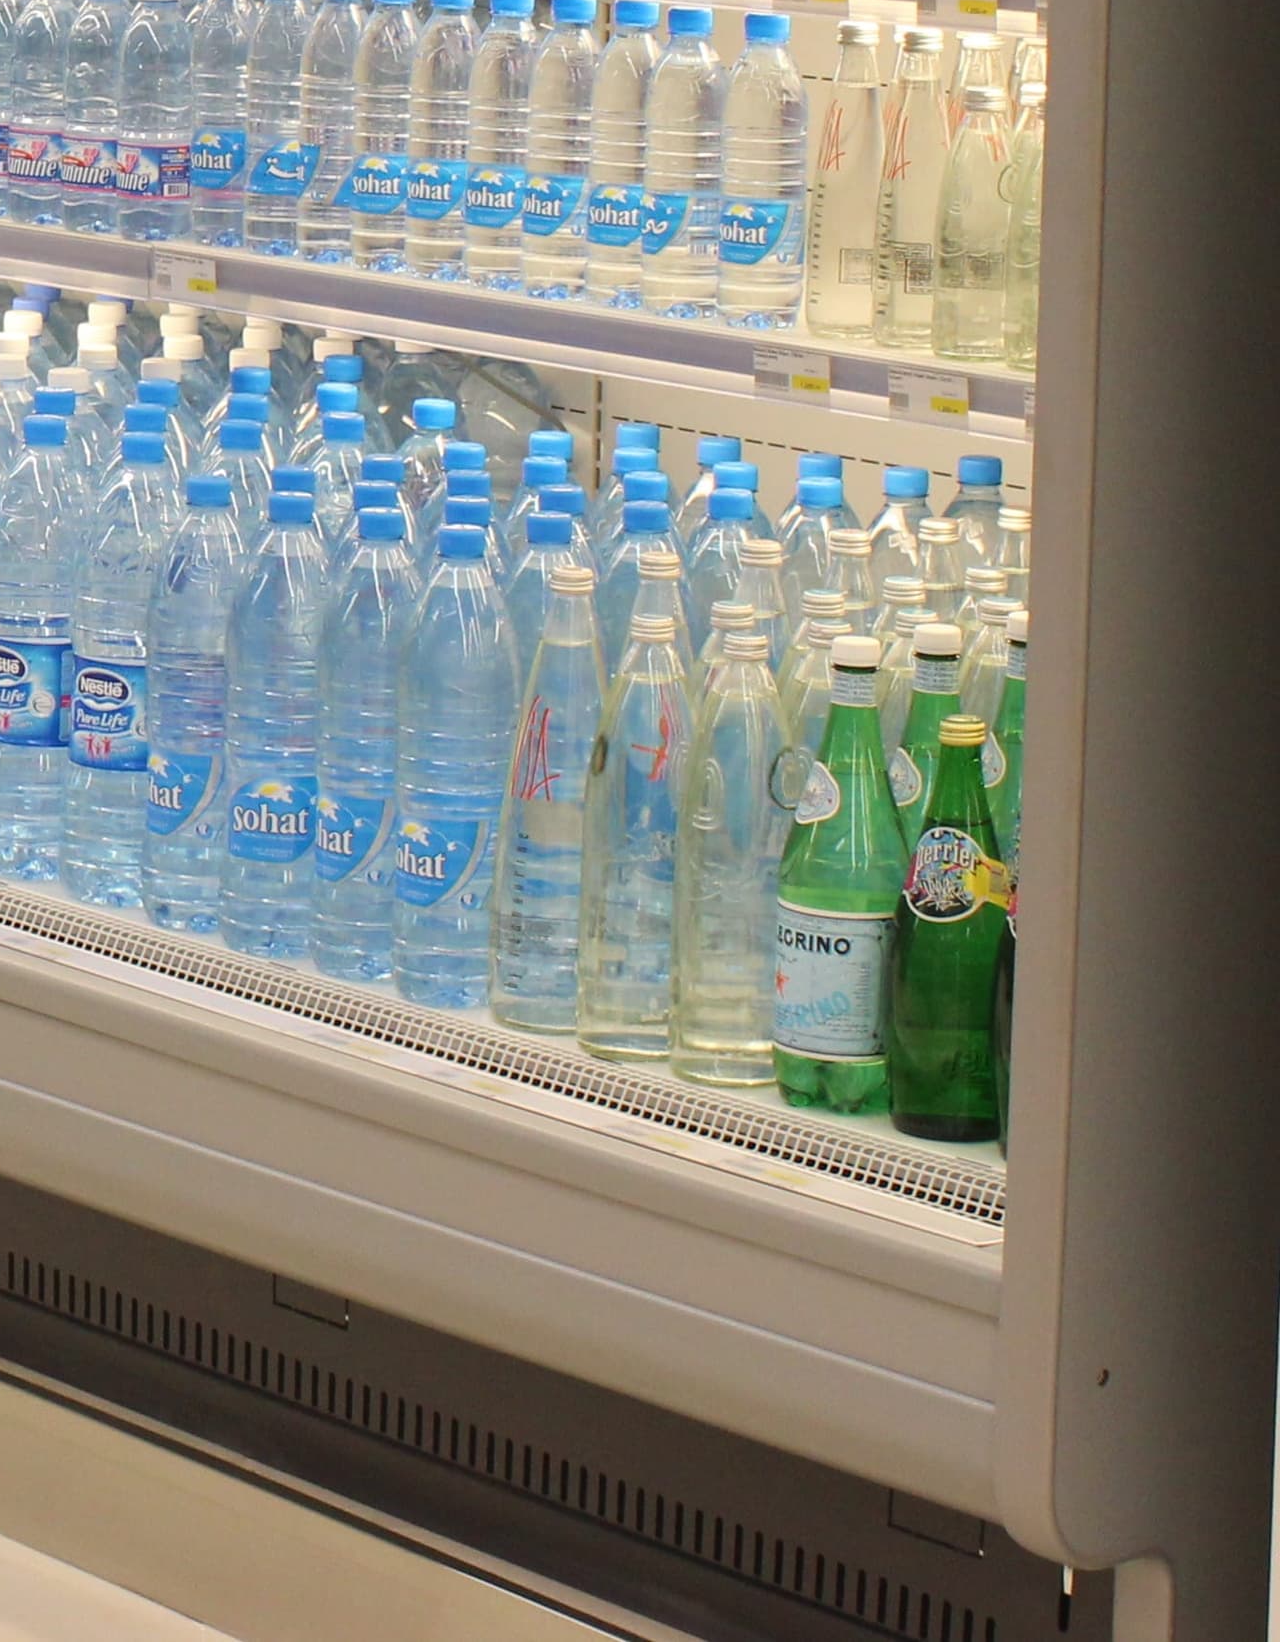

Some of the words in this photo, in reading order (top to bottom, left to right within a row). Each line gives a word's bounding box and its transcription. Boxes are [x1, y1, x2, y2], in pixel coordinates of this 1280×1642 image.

[8, 154, 58, 179] annine
[61, 161, 113, 185] annine
[352, 173, 401, 195] sohat
[466, 185, 516, 211] sohat
[523, 195, 561, 217] ohat
[0, 687, 26, 705] Life
[75, 706, 101, 726] Pure
[100, 711, 130, 730] Life
[149, 776, 183, 811] hat
[318, 818, 353, 857] hat
[396, 843, 446, 881] ohat
